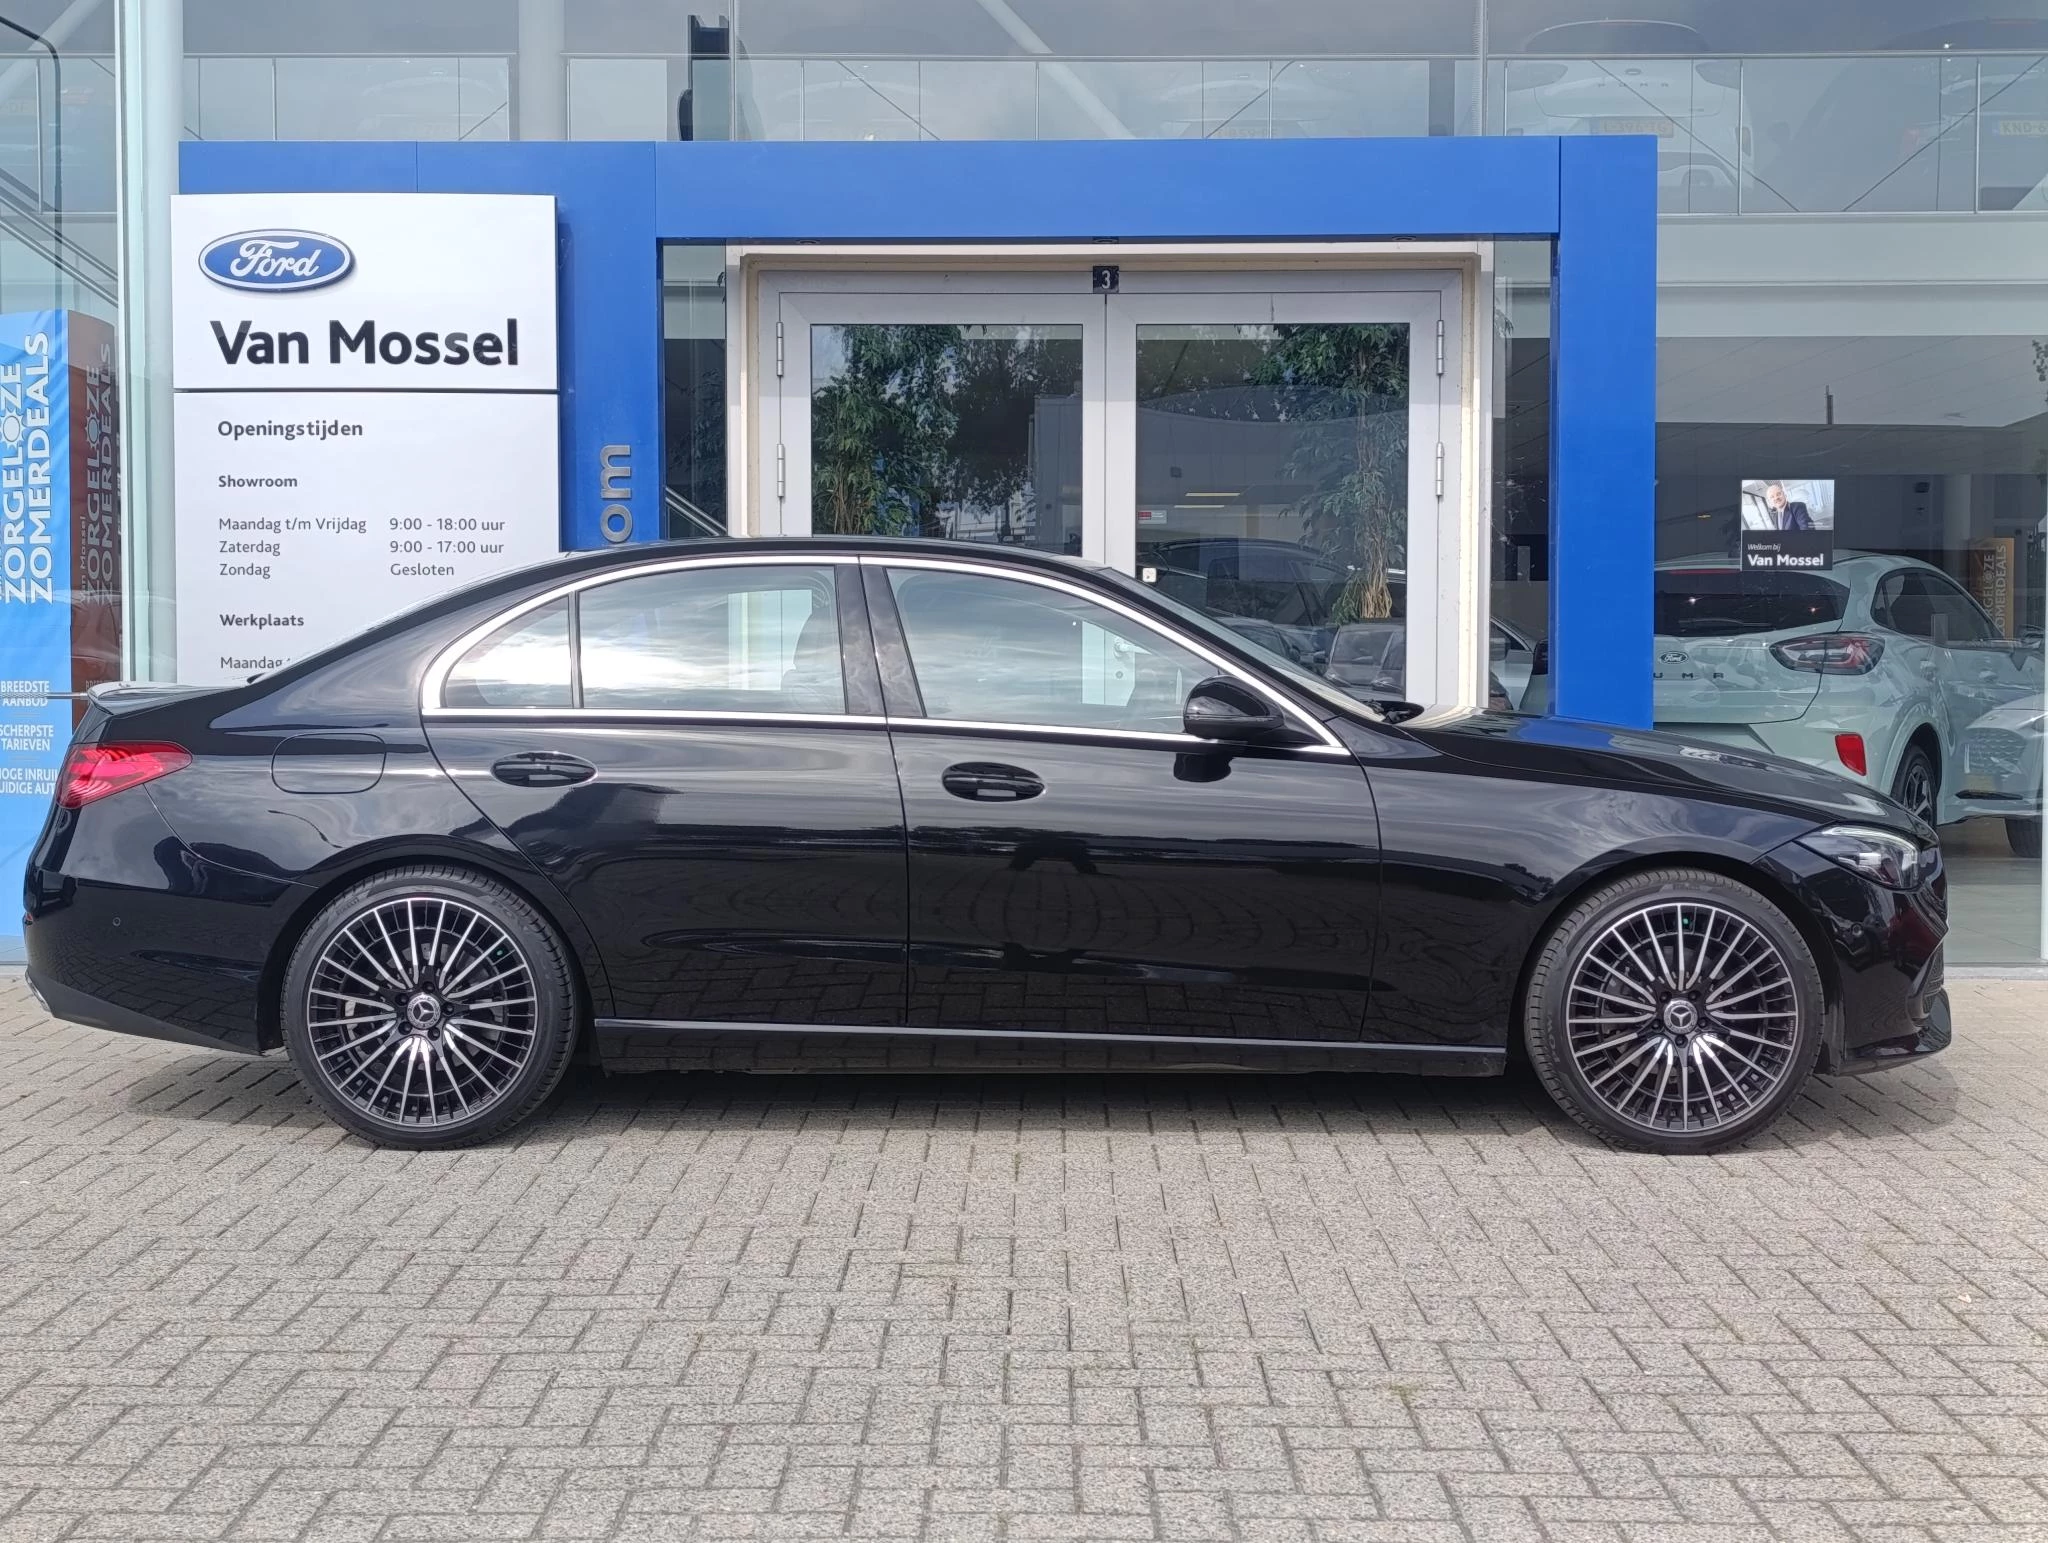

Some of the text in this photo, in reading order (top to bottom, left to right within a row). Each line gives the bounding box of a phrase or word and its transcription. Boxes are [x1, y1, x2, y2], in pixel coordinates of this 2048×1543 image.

[229, 239, 322, 277] Ford
[1101, 269, 1111, 289] 3
[209, 318, 519, 366] Van Mossel
[217, 420, 364, 440] Openingstijden
[24, 332, 53, 605] ZOMERDEALS
[218, 474, 299, 489] Showroom
[219, 517, 282, 534] Maandag
[286, 517, 311, 531] t/m
[315, 517, 368, 534] Vrijdag
[389, 517, 423, 531] 9:00
[436, 518, 477, 531] 18:00
[481, 521, 506, 531] uur
[219, 540, 281, 557] Zaterdag
[390, 540, 423, 553] 9:00
[437, 541, 476, 554] 17:00
[480, 544, 505, 554] uur
[1747, 553, 1824, 566] Van Mossel
[219, 562, 455, 580] Zondag Gesloten
[219, 613, 305, 631] Werkplaats
[220, 655, 283, 669] Maandag
[0, 680, 50, 693] BREEDSTE
[0, 724, 54, 737] SCHERPSTE
[1, 738, 51, 751] TARIEVEN
[0, 767, 23, 780] OGE
[0, 781, 56, 794] UIDIGE AUT
